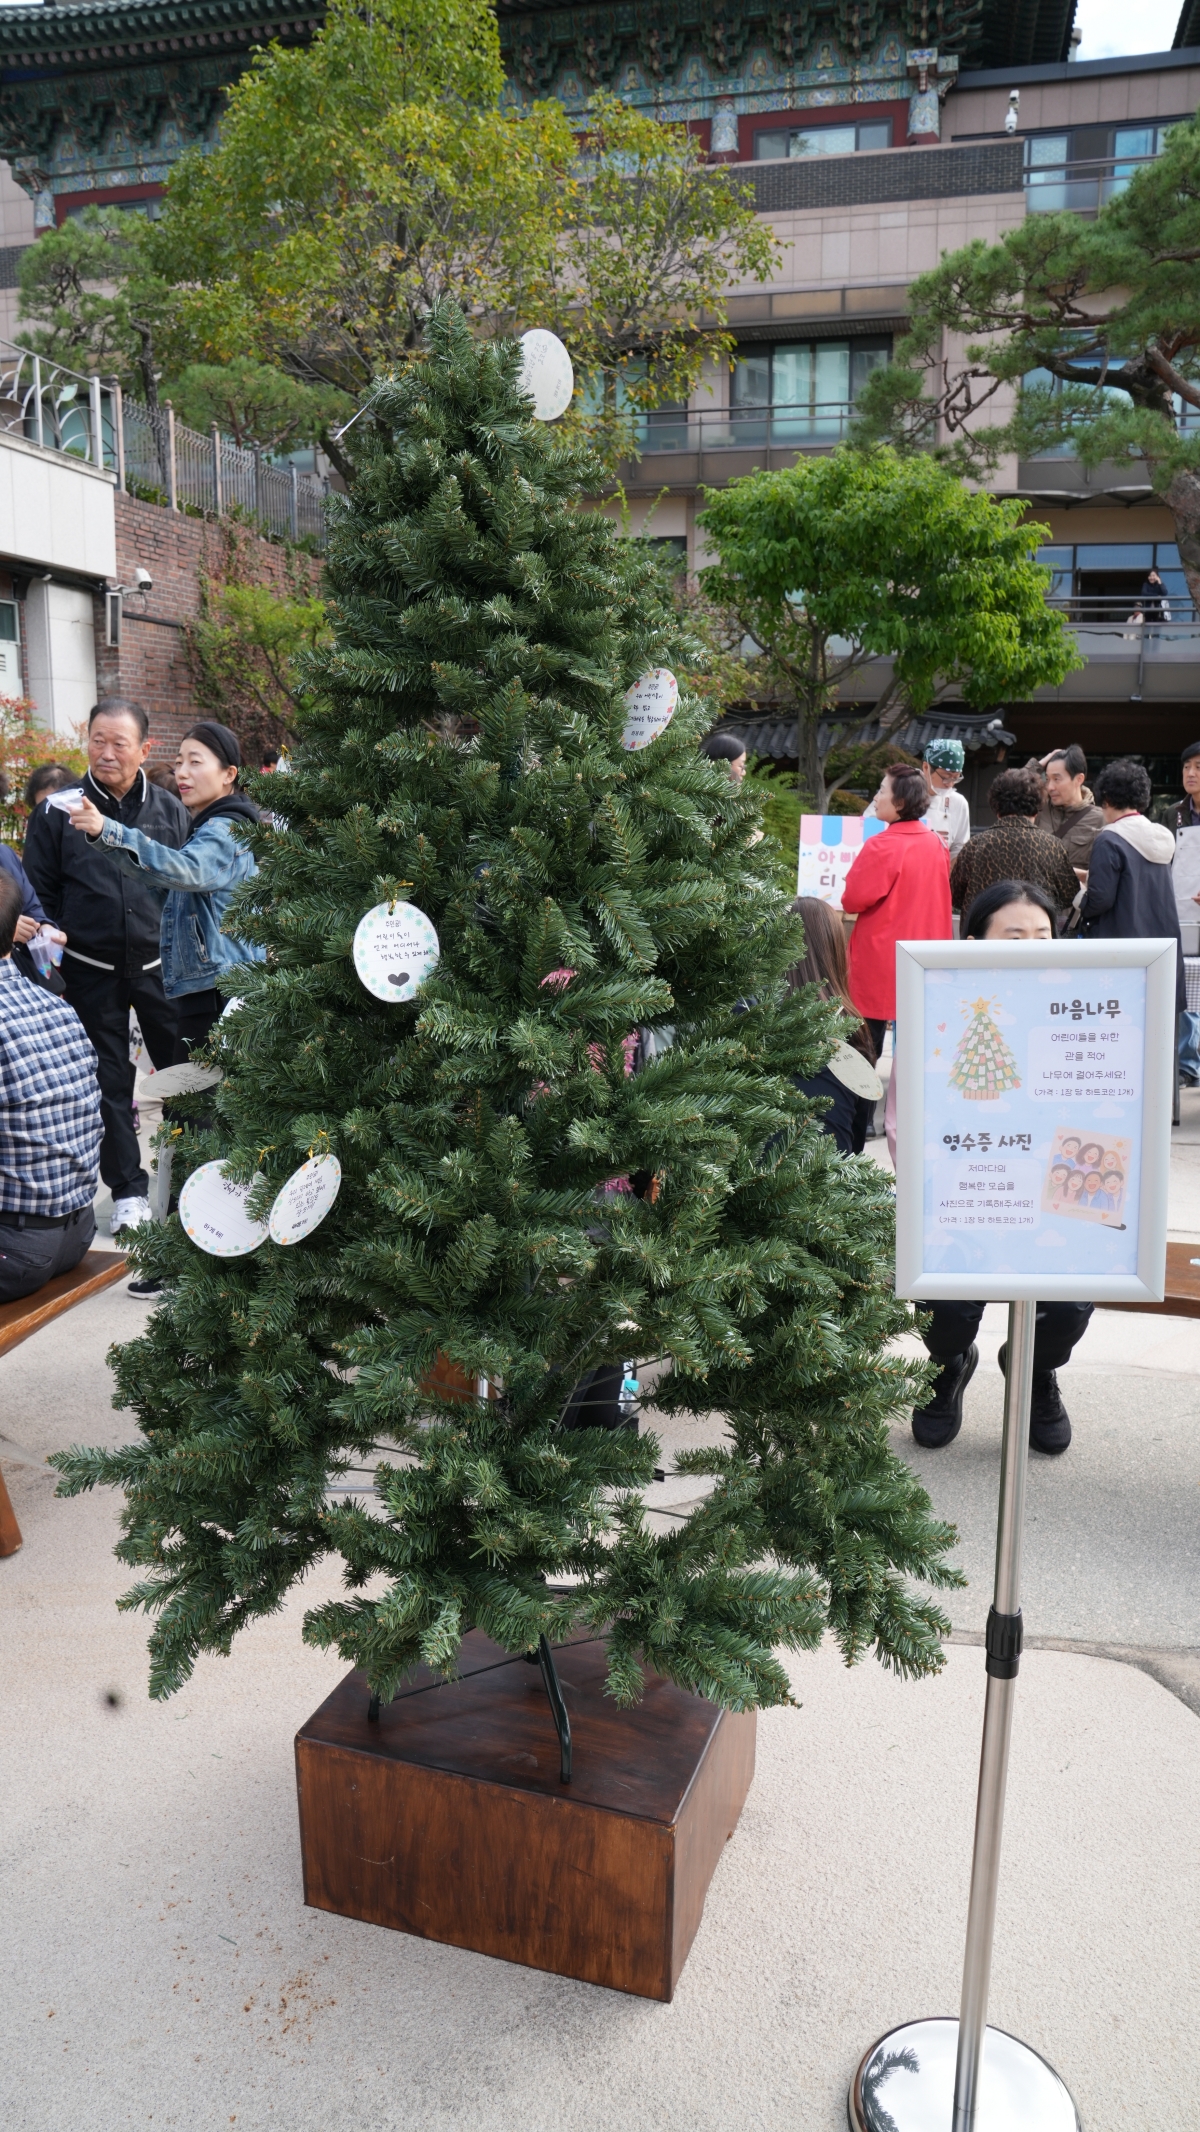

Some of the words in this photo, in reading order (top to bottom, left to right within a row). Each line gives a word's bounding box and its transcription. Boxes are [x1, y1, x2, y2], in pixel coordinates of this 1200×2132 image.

[1050, 999, 1122, 1021] 마음나무
[1051, 1032, 1097, 1042] 어린이들을
[1100, 1032, 1119, 1042] 위한
[1087, 1051, 1105, 1061] 적어
[1042, 1071, 1073, 1080] 나무에
[1076, 1070, 1126, 1080] 걸어주세요!
[1034, 1088, 1053, 1097] (가격
[1061, 1088, 1072, 1097] 1장
[1075, 1088, 1083, 1097] 당
[1086, 1088, 1116, 1097] 하트코인
[1117, 1088, 1134, 1097] 1개)
[943, 1132, 993, 1152] 영수증
[998, 1134, 1032, 1151] 사진
[968, 1164, 1006, 1173] 저마다의
[959, 1181, 986, 1191] 행복한
[988, 1181, 1015, 1191] 모습을
[940, 1199, 975, 1208] 사진으로
[977, 1199, 1034, 1208] 기록해주세요!
[939, 1216, 957, 1225] (가격
[964, 1216, 975, 1225] 1장
[977, 1216, 985, 1225] 당
[987, 1216, 1017, 1225] 하트코인
[1019, 1216, 1034, 1225] 1개)
